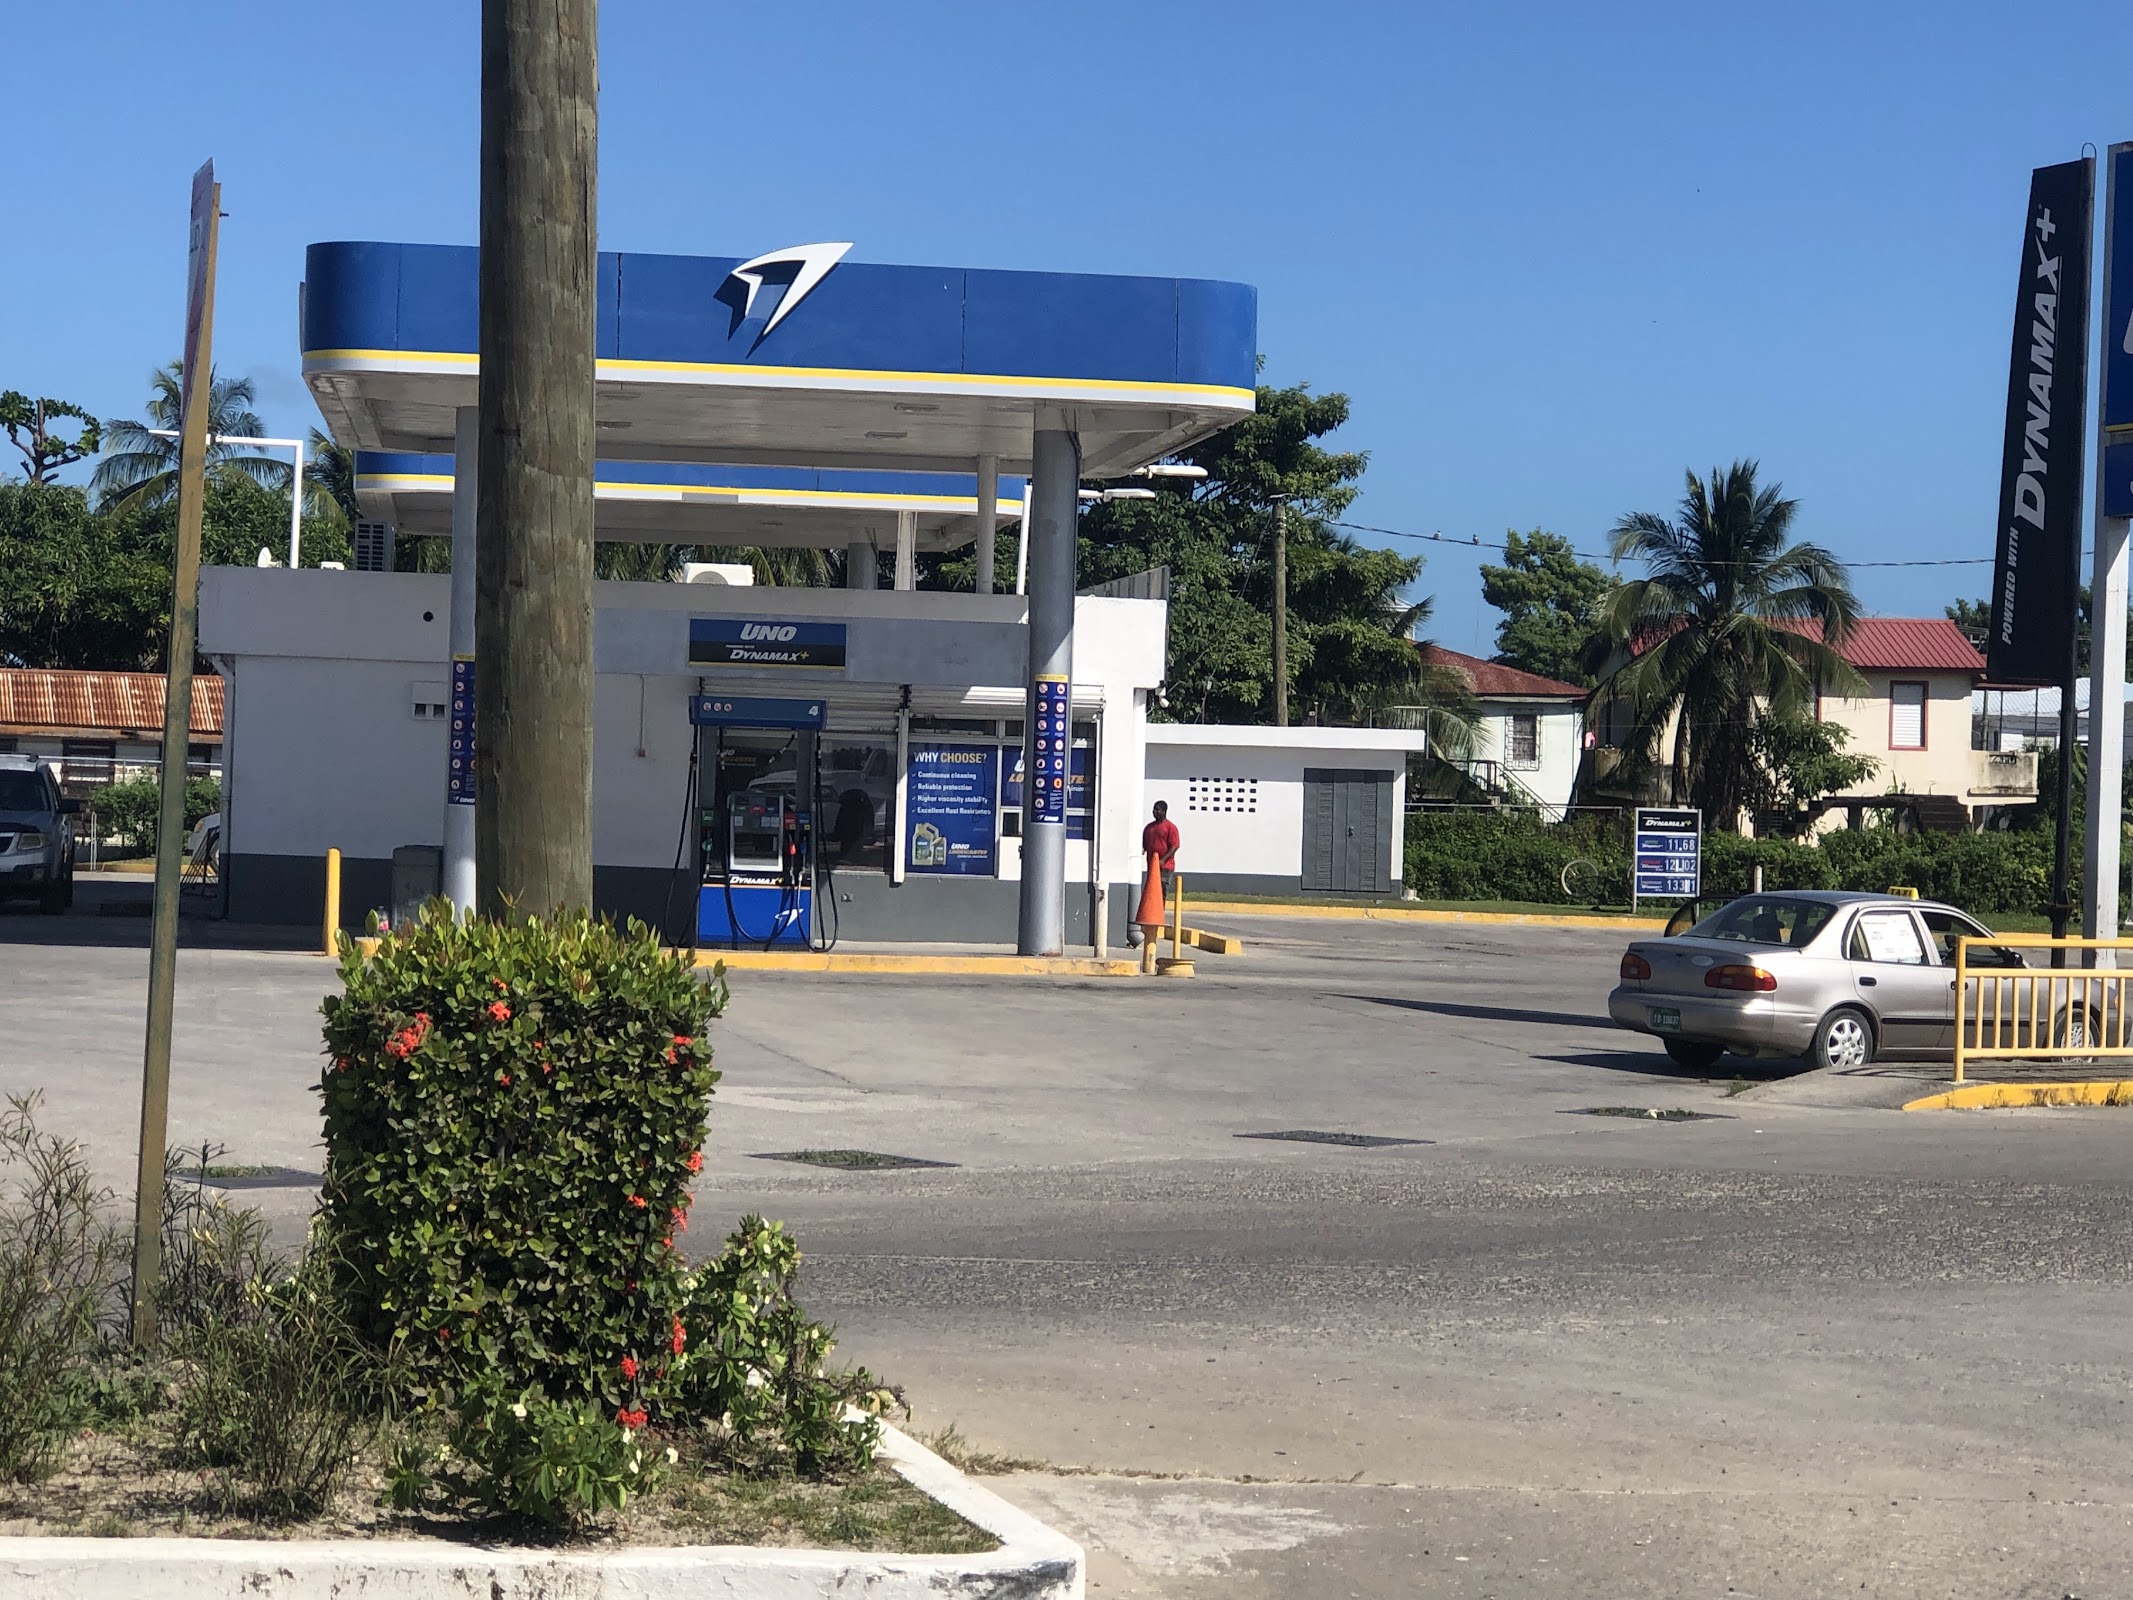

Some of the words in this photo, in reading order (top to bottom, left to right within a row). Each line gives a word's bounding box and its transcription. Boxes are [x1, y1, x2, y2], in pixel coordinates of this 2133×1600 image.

[2007, 527, 2019, 569] WITH
[2002, 571, 2016, 646] POWERED
[740, 623, 797, 642] UNO
[808, 705, 819, 716] 4
[914, 752, 939, 763] WHY
[940, 752, 987, 764] CHOOSE?
[917, 771, 950, 779] Continuous
[951, 772, 977, 780] cleaning
[917, 795, 937, 803] Higher
[938, 796, 964, 804] viscosity
[965, 796, 988, 804] stability
[1668, 838, 1695, 851] 11.68
[1890, 888, 1913, 897] TAXI
